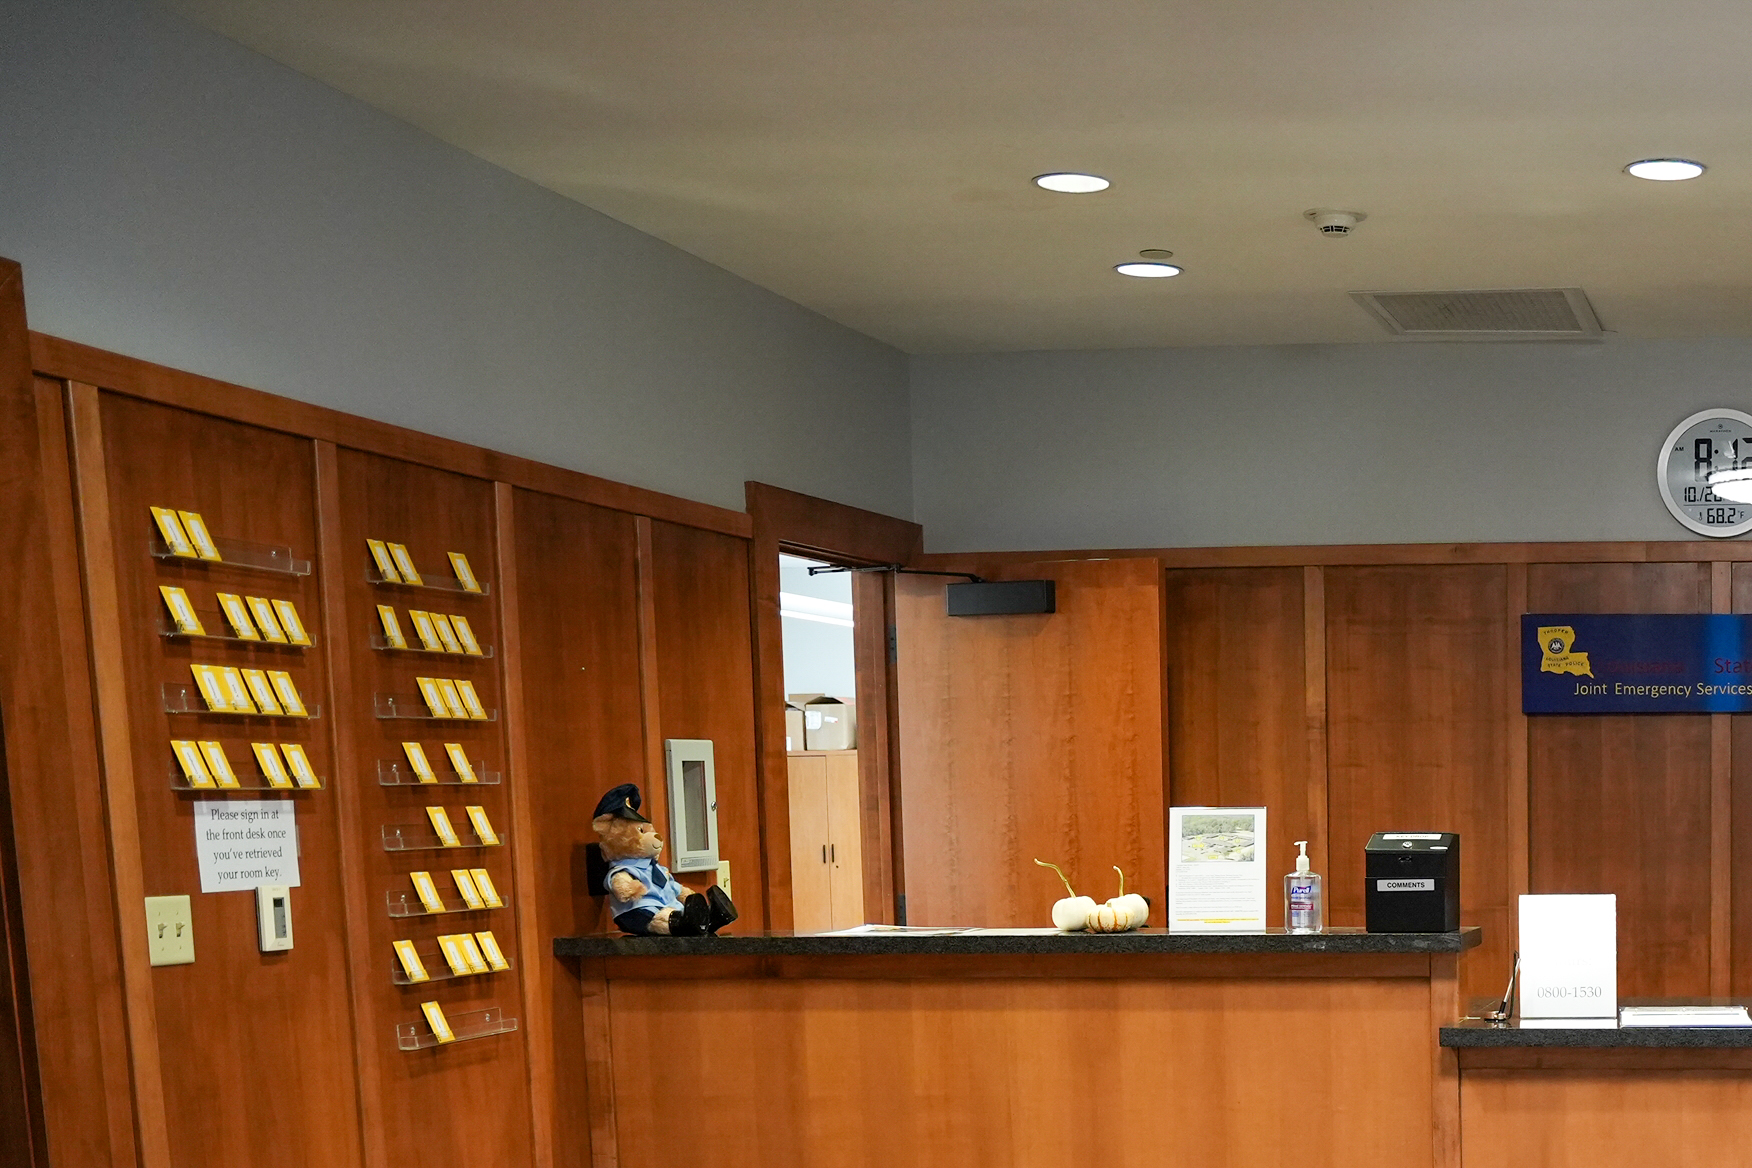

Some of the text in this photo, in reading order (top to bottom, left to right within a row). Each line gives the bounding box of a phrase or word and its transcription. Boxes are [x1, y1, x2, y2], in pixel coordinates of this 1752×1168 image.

[1706, 508, 1736, 524] 68.2
[1574, 683, 1607, 696] Joint
[1615, 683, 1692, 698] Emergency
[1696, 682, 1752, 696] Services
[211, 808, 280, 823] Please sign in at
[206, 827, 287, 841] the front desk once
[213, 846, 283, 864] you've retrieved
[217, 866, 282, 884] your room key.
[1537, 986, 1602, 998] 0800-1530
